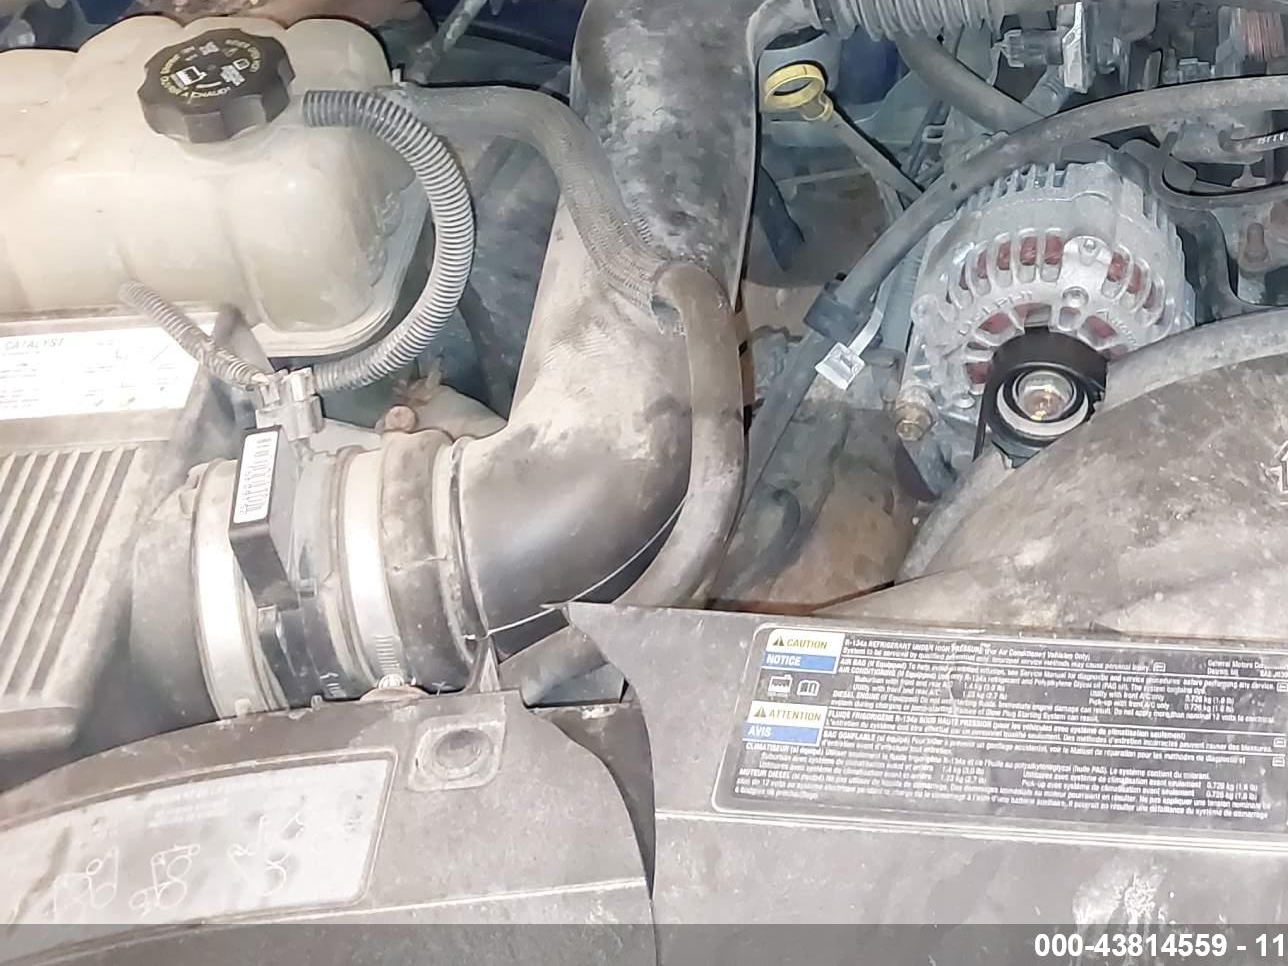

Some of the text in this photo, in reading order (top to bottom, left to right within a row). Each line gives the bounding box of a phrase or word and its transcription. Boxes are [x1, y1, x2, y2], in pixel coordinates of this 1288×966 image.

[787, 639, 828, 650] CAUTION
[766, 655, 801, 666] NOTICE
[768, 709, 821, 721] ATTENTION
[748, 725, 772, 737] AVIS
